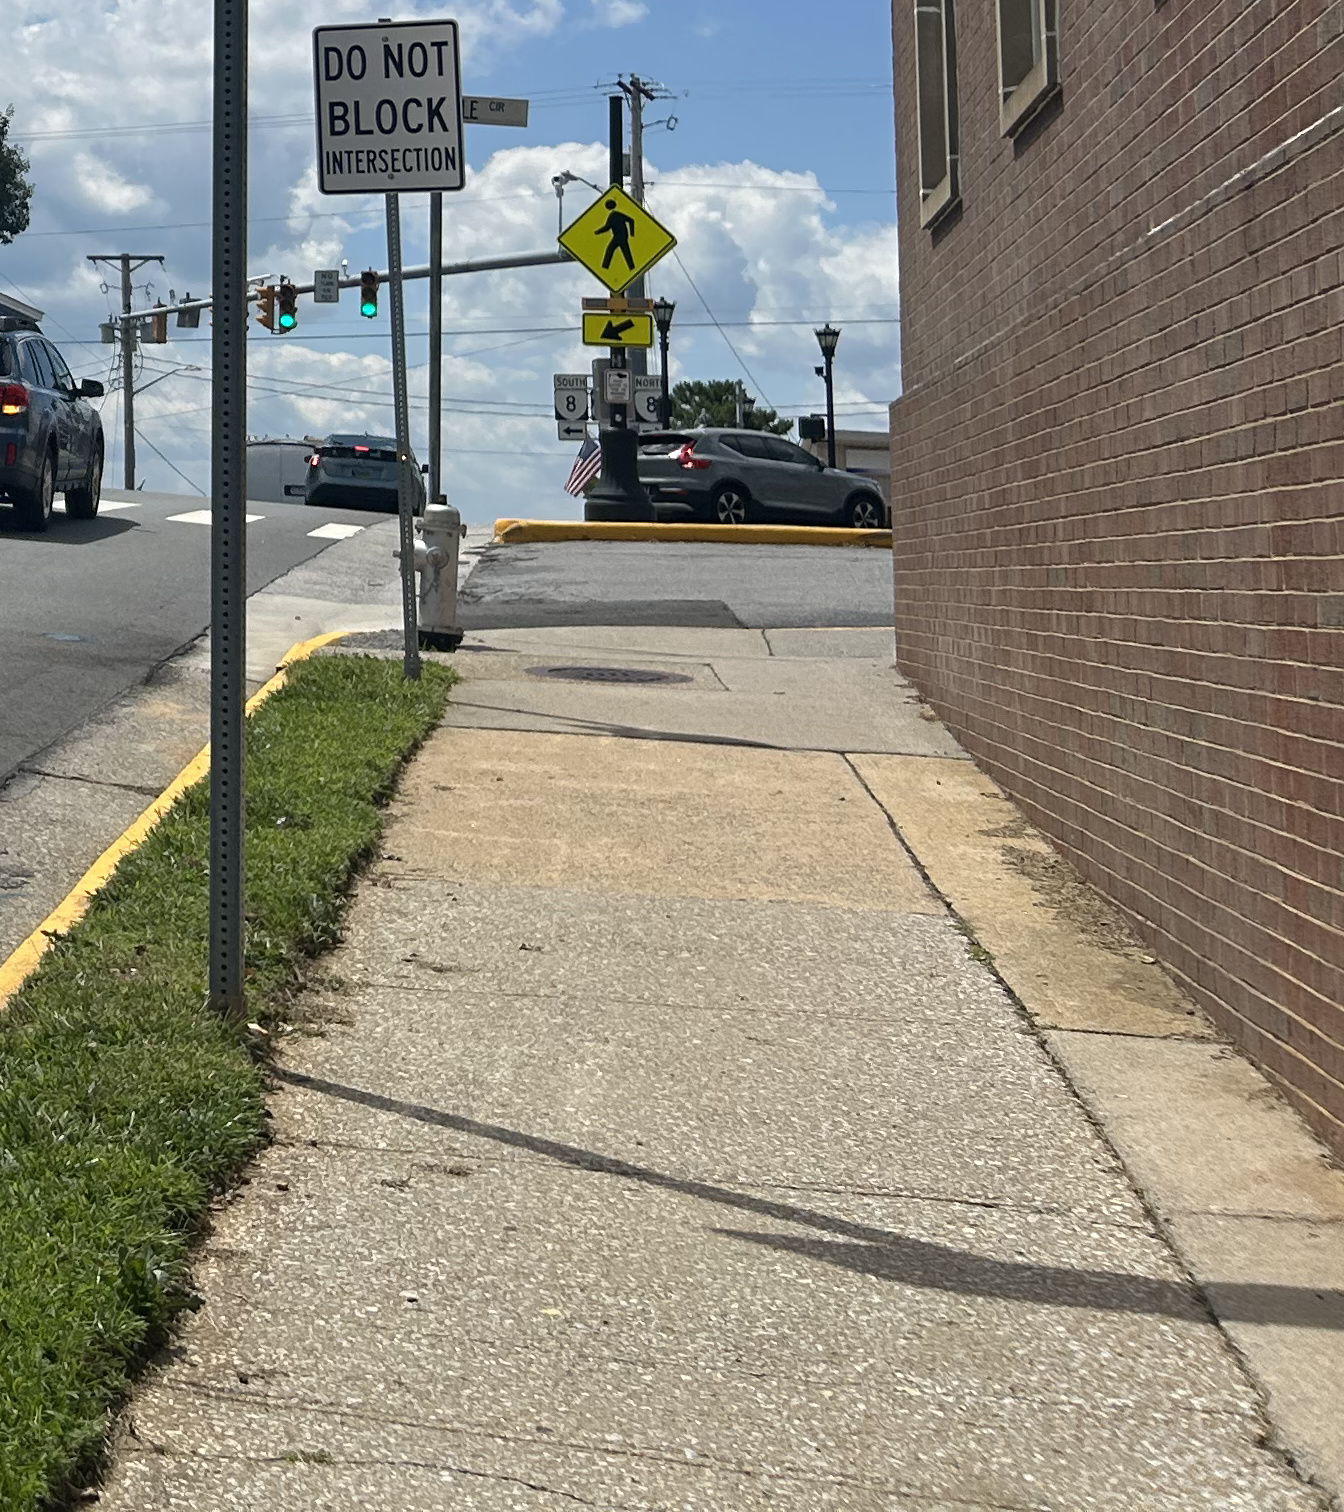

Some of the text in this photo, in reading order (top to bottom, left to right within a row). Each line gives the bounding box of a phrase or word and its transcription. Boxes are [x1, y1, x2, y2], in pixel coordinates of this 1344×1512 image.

[324, 40, 449, 81] DO NOT
[328, 96, 450, 136] BLOCK
[489, 101, 506, 112] CIR
[325, 146, 457, 175] INTERSECTION
[566, 395, 576, 412] 8
[646, 396, 657, 413] 8
